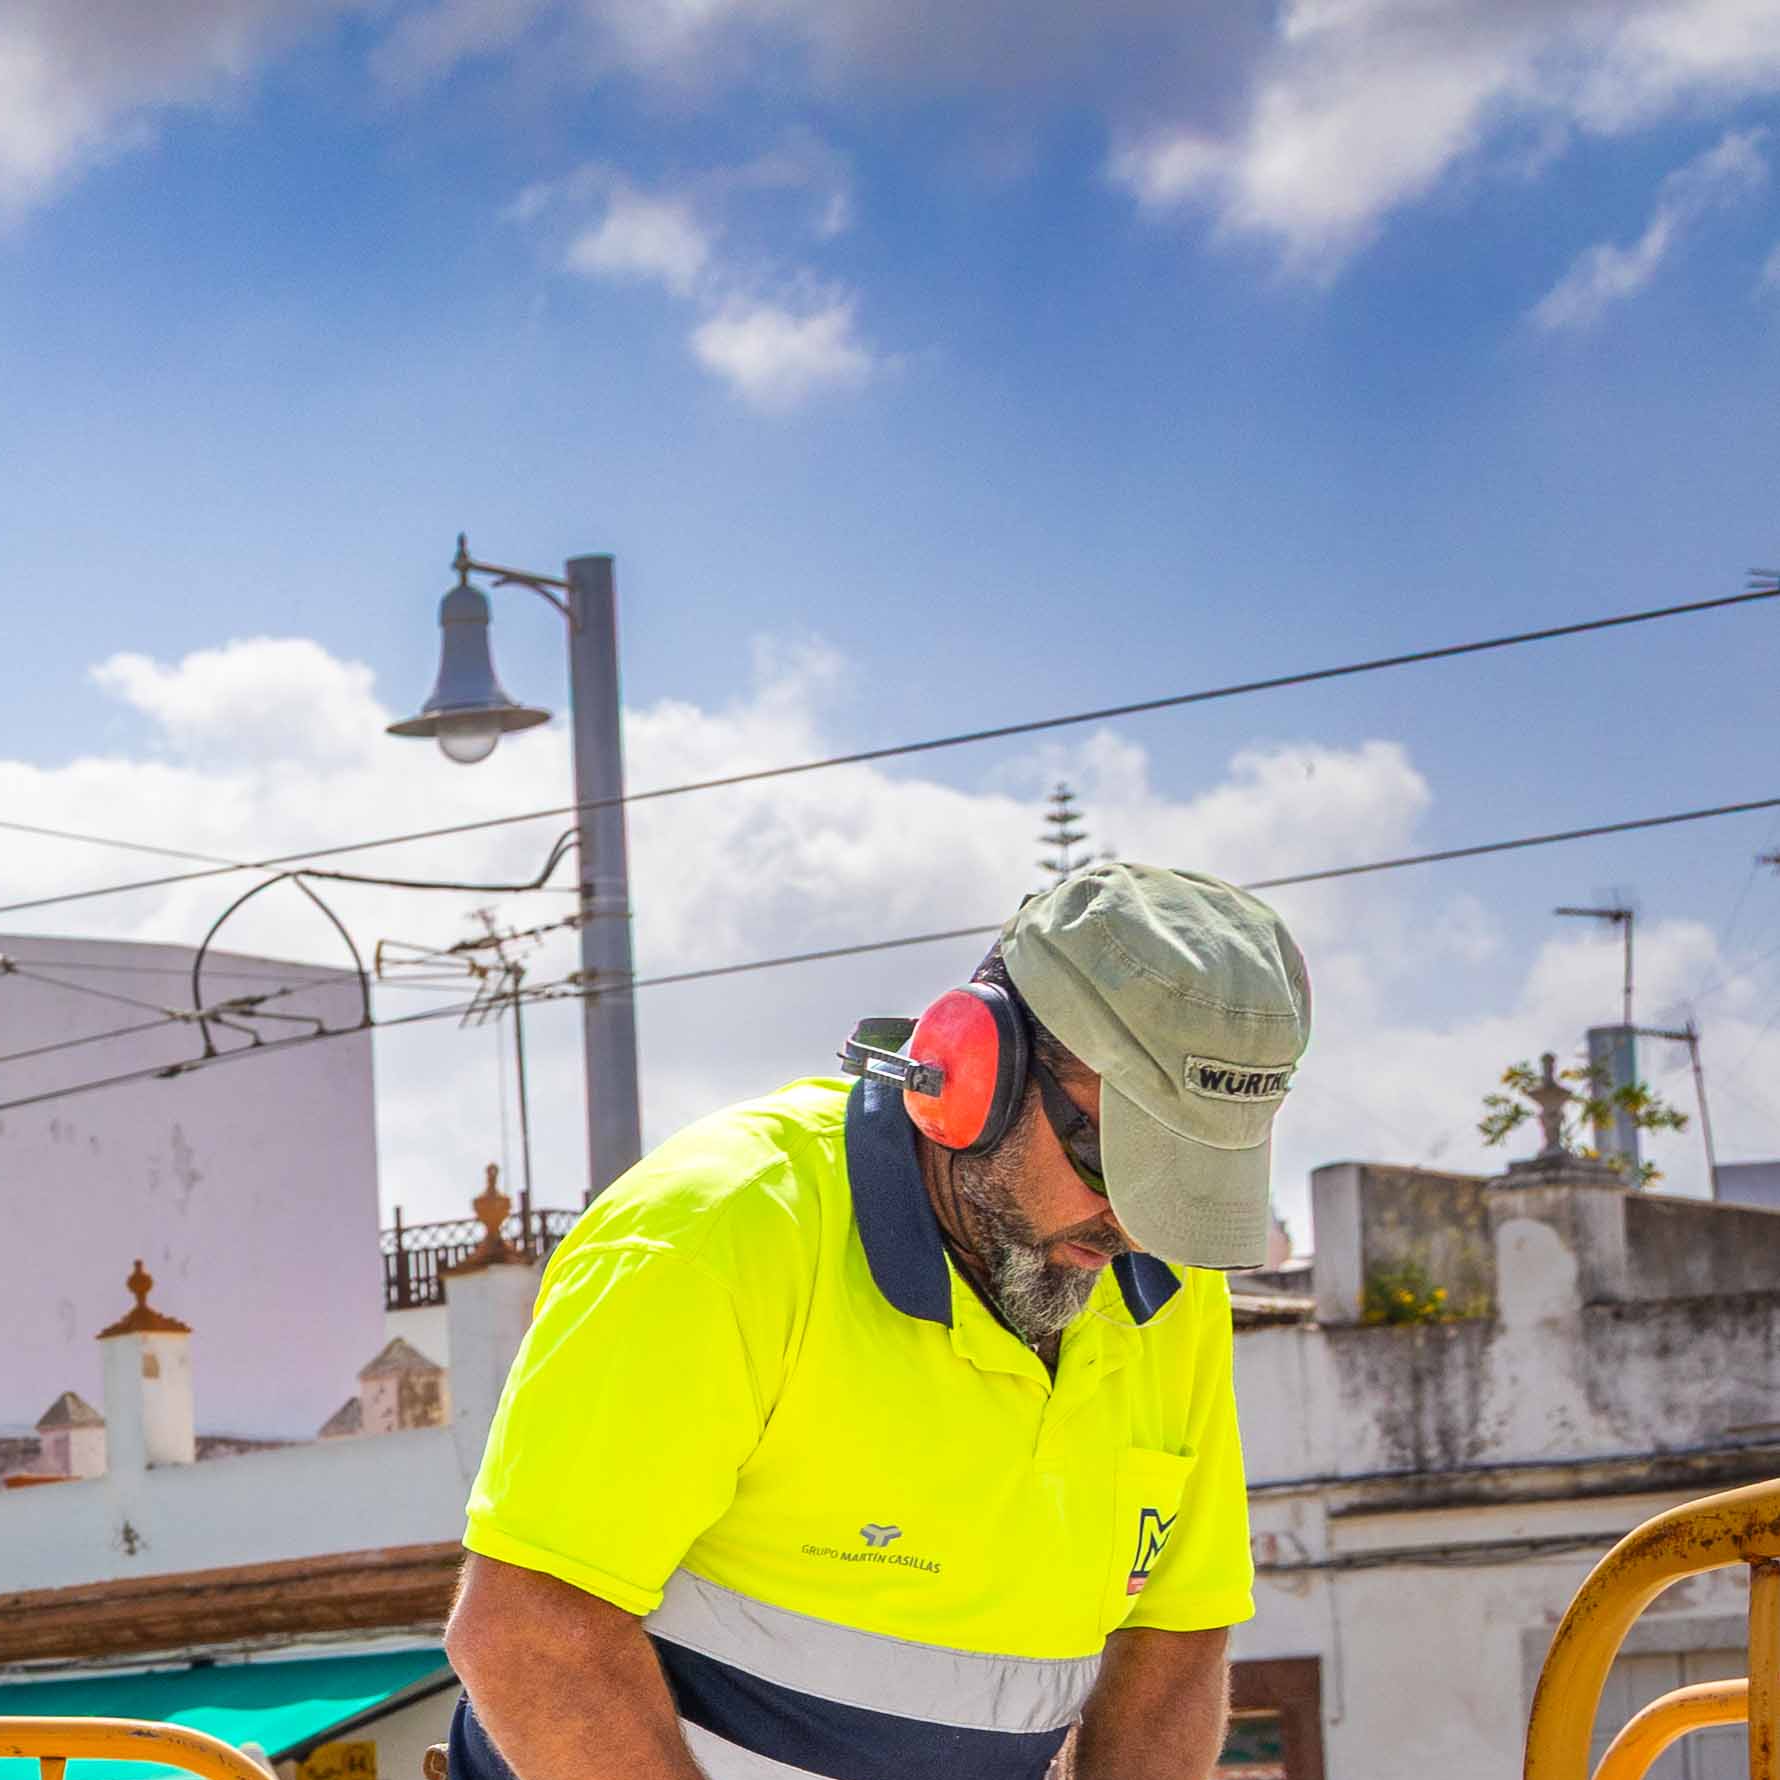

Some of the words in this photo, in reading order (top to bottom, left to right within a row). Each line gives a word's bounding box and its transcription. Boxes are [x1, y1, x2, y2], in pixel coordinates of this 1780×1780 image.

[801, 1544, 839, 1559] GRUPO
[840, 1551, 887, 1564] MARTÍN
[888, 1554, 941, 1574] CASILLAS
